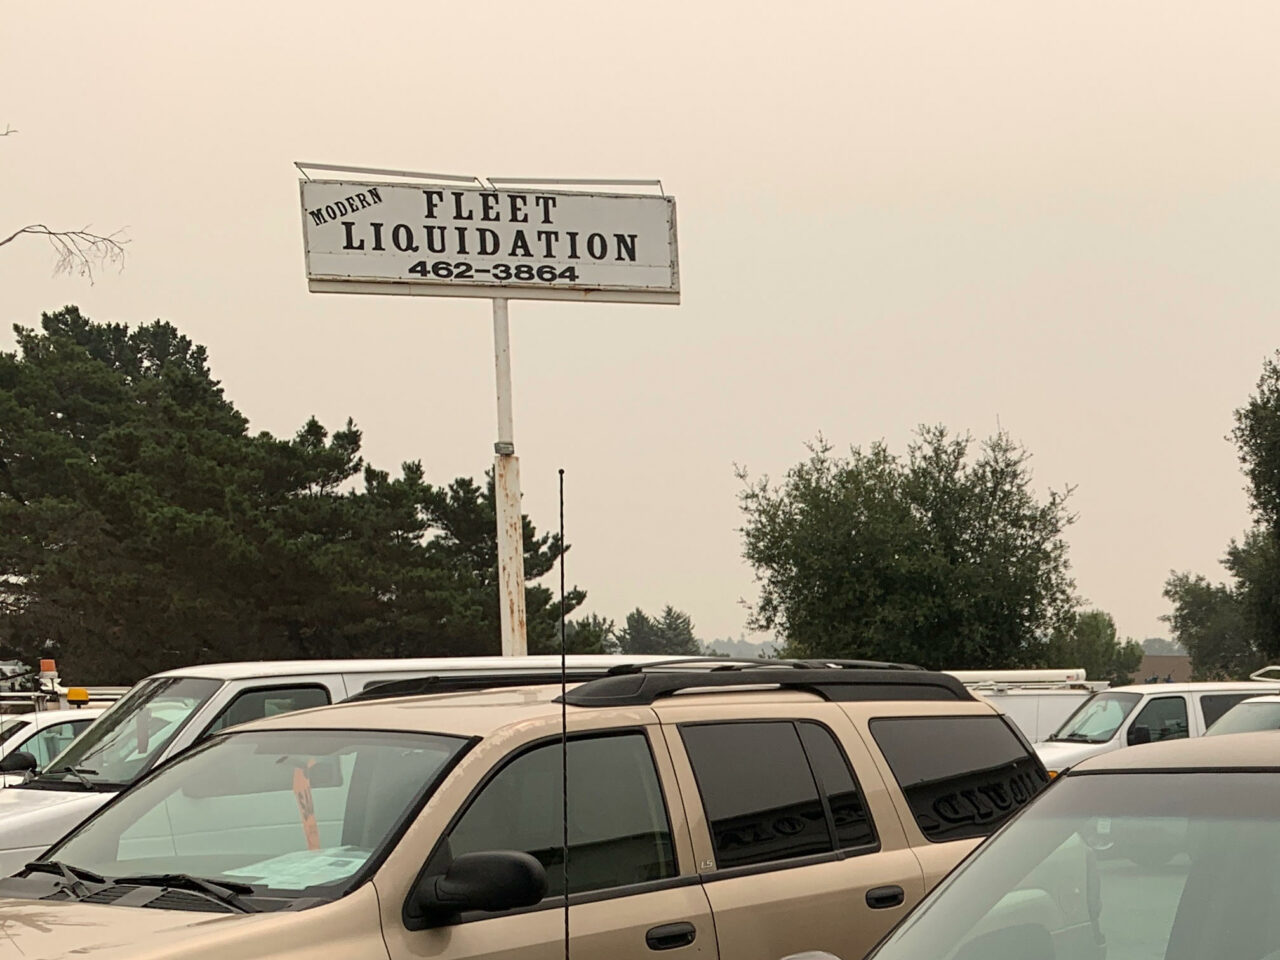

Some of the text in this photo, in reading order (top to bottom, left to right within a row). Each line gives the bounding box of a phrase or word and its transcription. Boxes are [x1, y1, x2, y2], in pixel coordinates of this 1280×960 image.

[309, 187, 384, 226] MODERN
[422, 190, 558, 224] FLEET
[341, 221, 638, 262] LIQUIDATION
[408, 260, 579, 283] 462-3864
